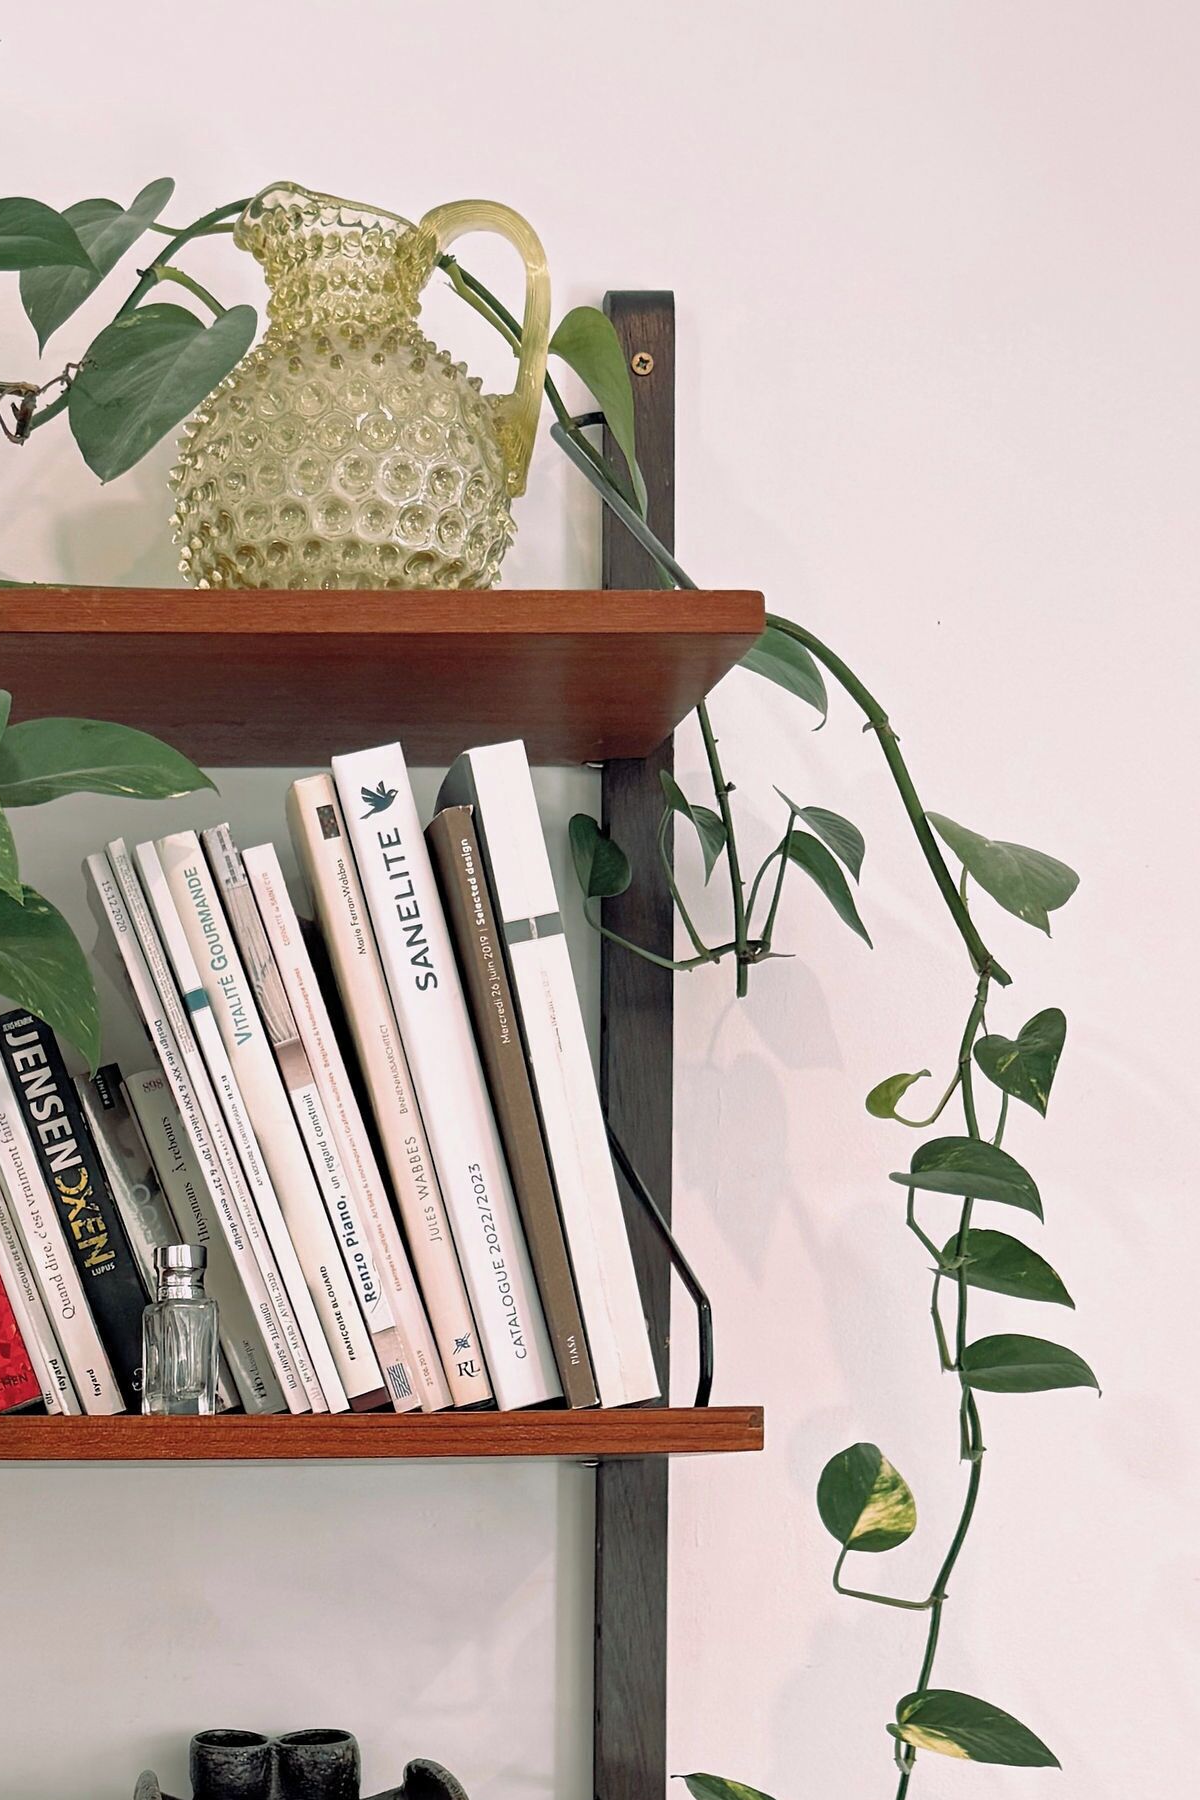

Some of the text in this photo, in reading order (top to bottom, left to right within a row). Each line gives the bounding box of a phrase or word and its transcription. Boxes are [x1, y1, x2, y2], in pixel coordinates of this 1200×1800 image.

[376, 827, 438, 991] SANELITE
[460, 838, 510, 1044] Mercredi 26 juin 2019 Selected design
[3, 1028, 85, 1175] JENSEN
[8, 1146, 35, 1207] vraiment
[300, 1090, 378, 1303] Renzo Piano, un regard construit
[404, 1136, 442, 1241] JULES WABBES
[30, 1209, 47, 1239] c'est
[43, 1241, 58, 1270] dire,
[467, 1163, 527, 1359] CATALOGUE 2022/2023
[48, 1273, 75, 1319] Quand
[91, 1261, 115, 1276] LUPUS
[48, 1358, 67, 1391] fayard
